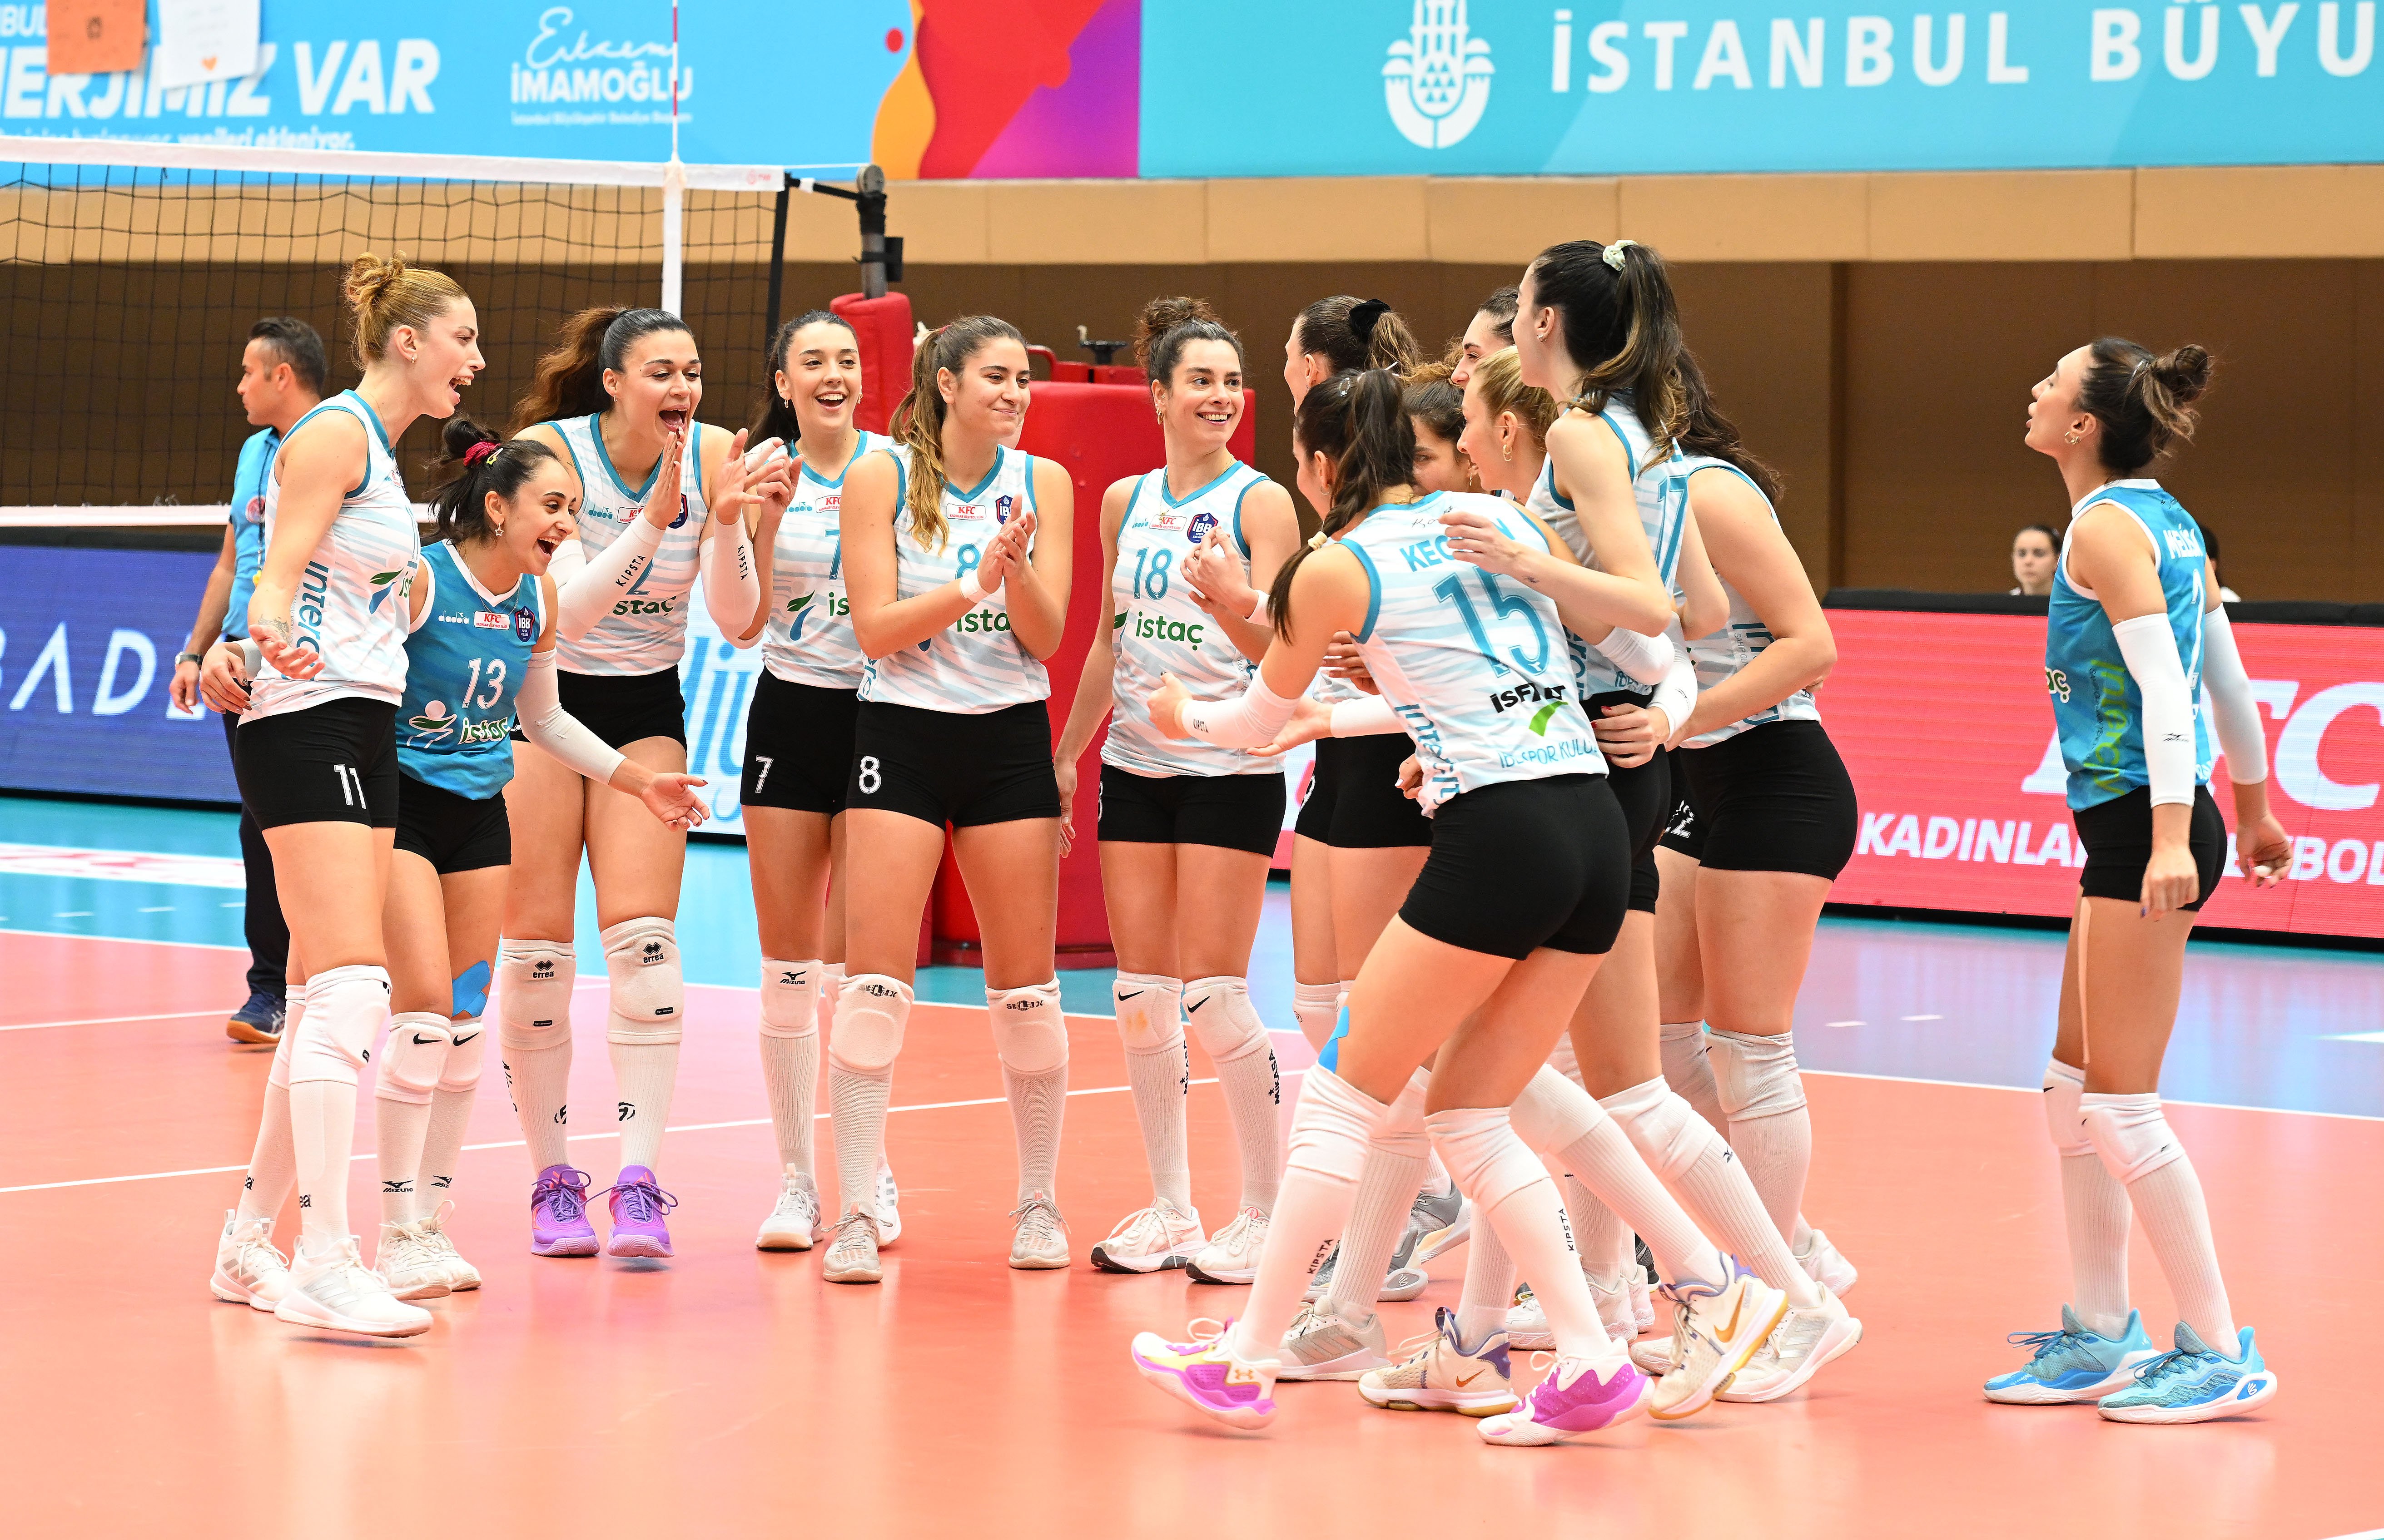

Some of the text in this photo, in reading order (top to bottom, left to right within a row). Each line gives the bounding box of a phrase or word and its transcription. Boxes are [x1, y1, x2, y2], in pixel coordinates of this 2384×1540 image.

[1552, 9, 2029, 93] İSTANBUL
[294, 38, 440, 116] VAR
[512, 63, 693, 103] İMAMOĞLU
[958, 506, 975, 515] KFC
[1161, 517, 1177, 525] KFC
[615, 555, 646, 587] KIPSTA
[738, 545, 748, 580] KIPSTA
[1133, 547, 1173, 600] 18
[438, 610, 469, 624] diadora
[484, 613, 501, 623] KFC
[612, 595, 677, 617] staç
[1432, 565, 1550, 678] 15
[1135, 611, 1204, 651] istaç
[462, 658, 507, 710] 13
[334, 764, 366, 810] 11
[756, 755, 774, 793] 7
[859, 755, 881, 795] 8
[1558, 1208, 1574, 1252] KIPSTA
[1306, 1238, 1335, 1275] KIPSTA
